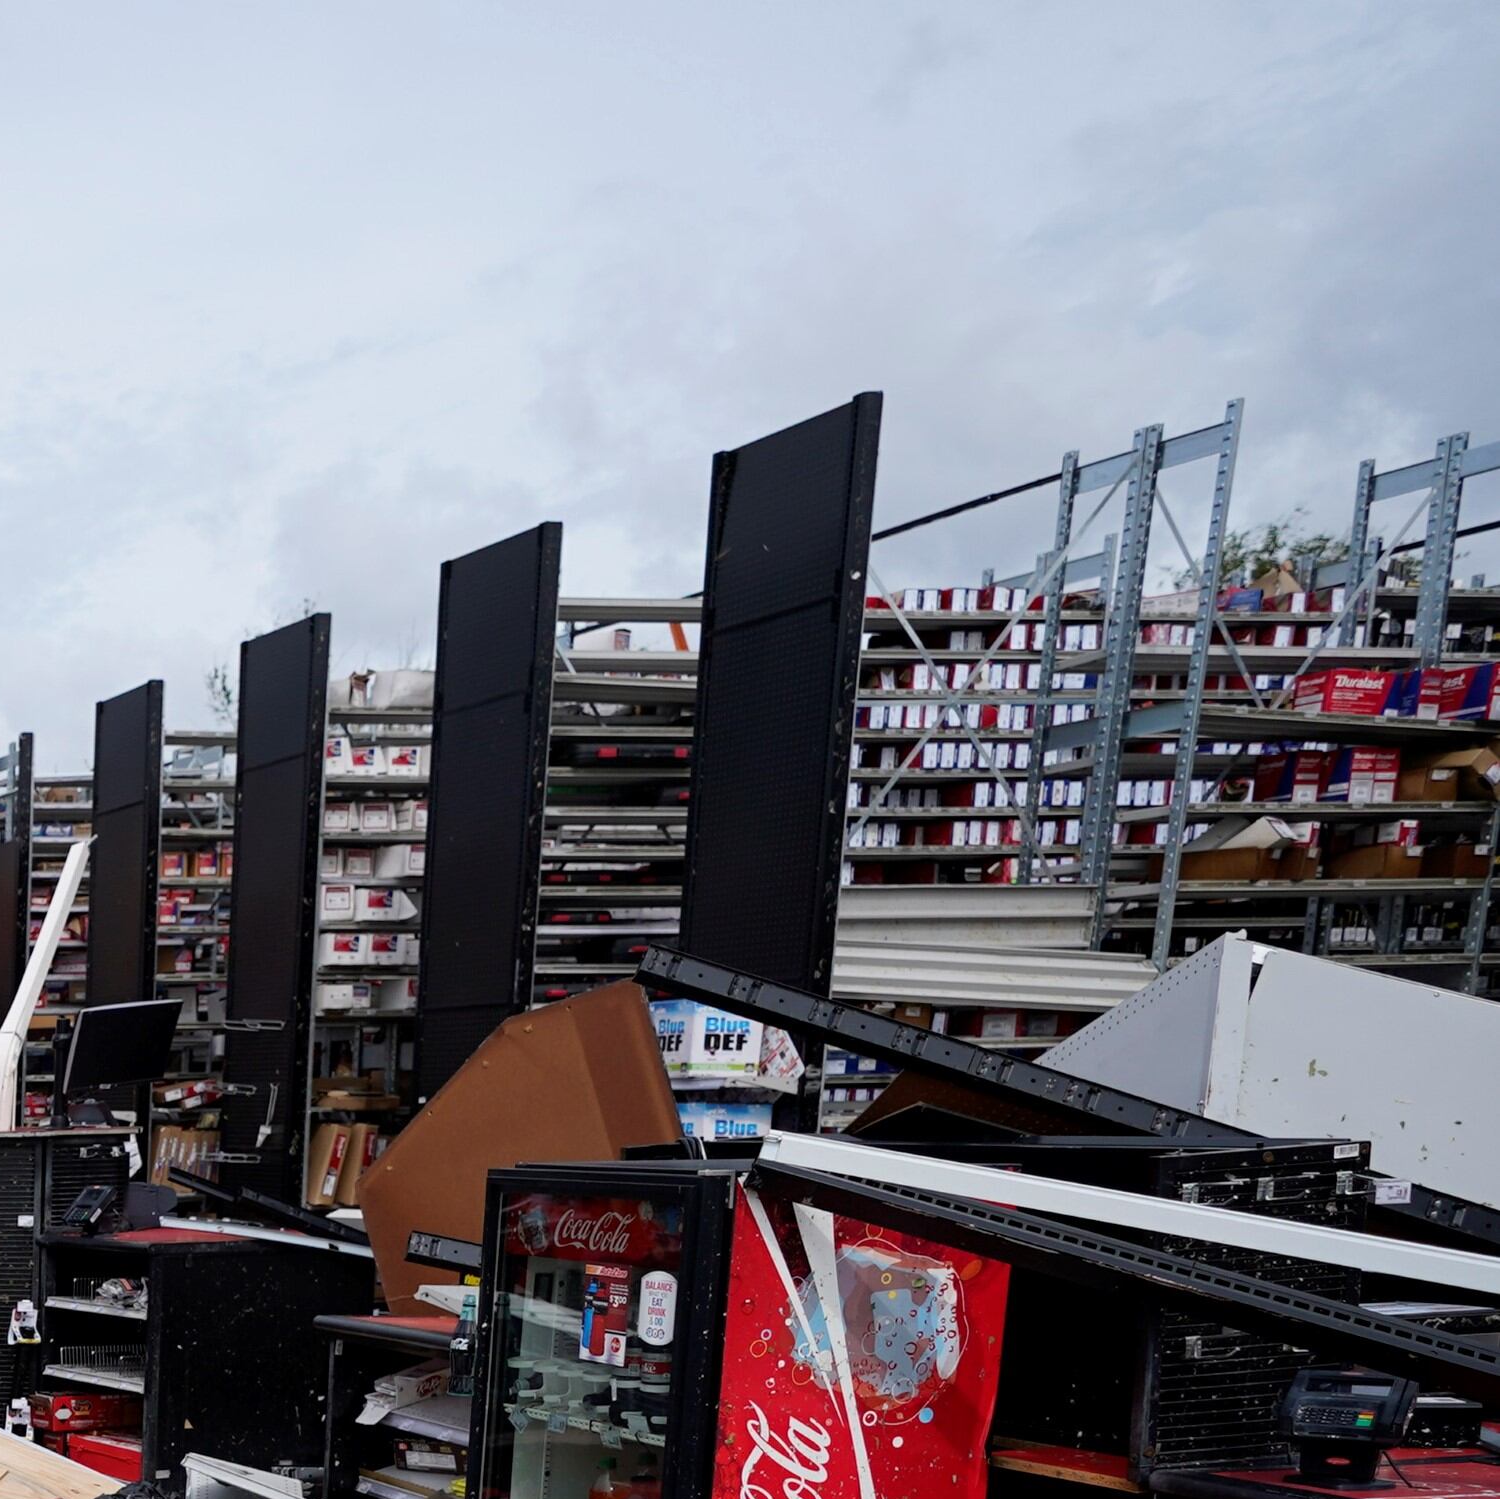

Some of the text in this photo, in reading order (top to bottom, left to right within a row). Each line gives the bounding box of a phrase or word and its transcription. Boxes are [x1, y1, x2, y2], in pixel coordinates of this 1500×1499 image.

[1335, 673, 1385, 690] Duralast
[658, 1019, 685, 1034] Blue
[705, 1017, 750, 1033] Blue
[704, 1034, 748, 1051] DEF
[715, 1119, 758, 1136] Blue
[554, 1208, 636, 1253] Coca-Cola
[645, 1281, 673, 1292] BALANCE
[652, 1297, 663, 1306] EAT
[648, 1307, 666, 1317] DRINK
